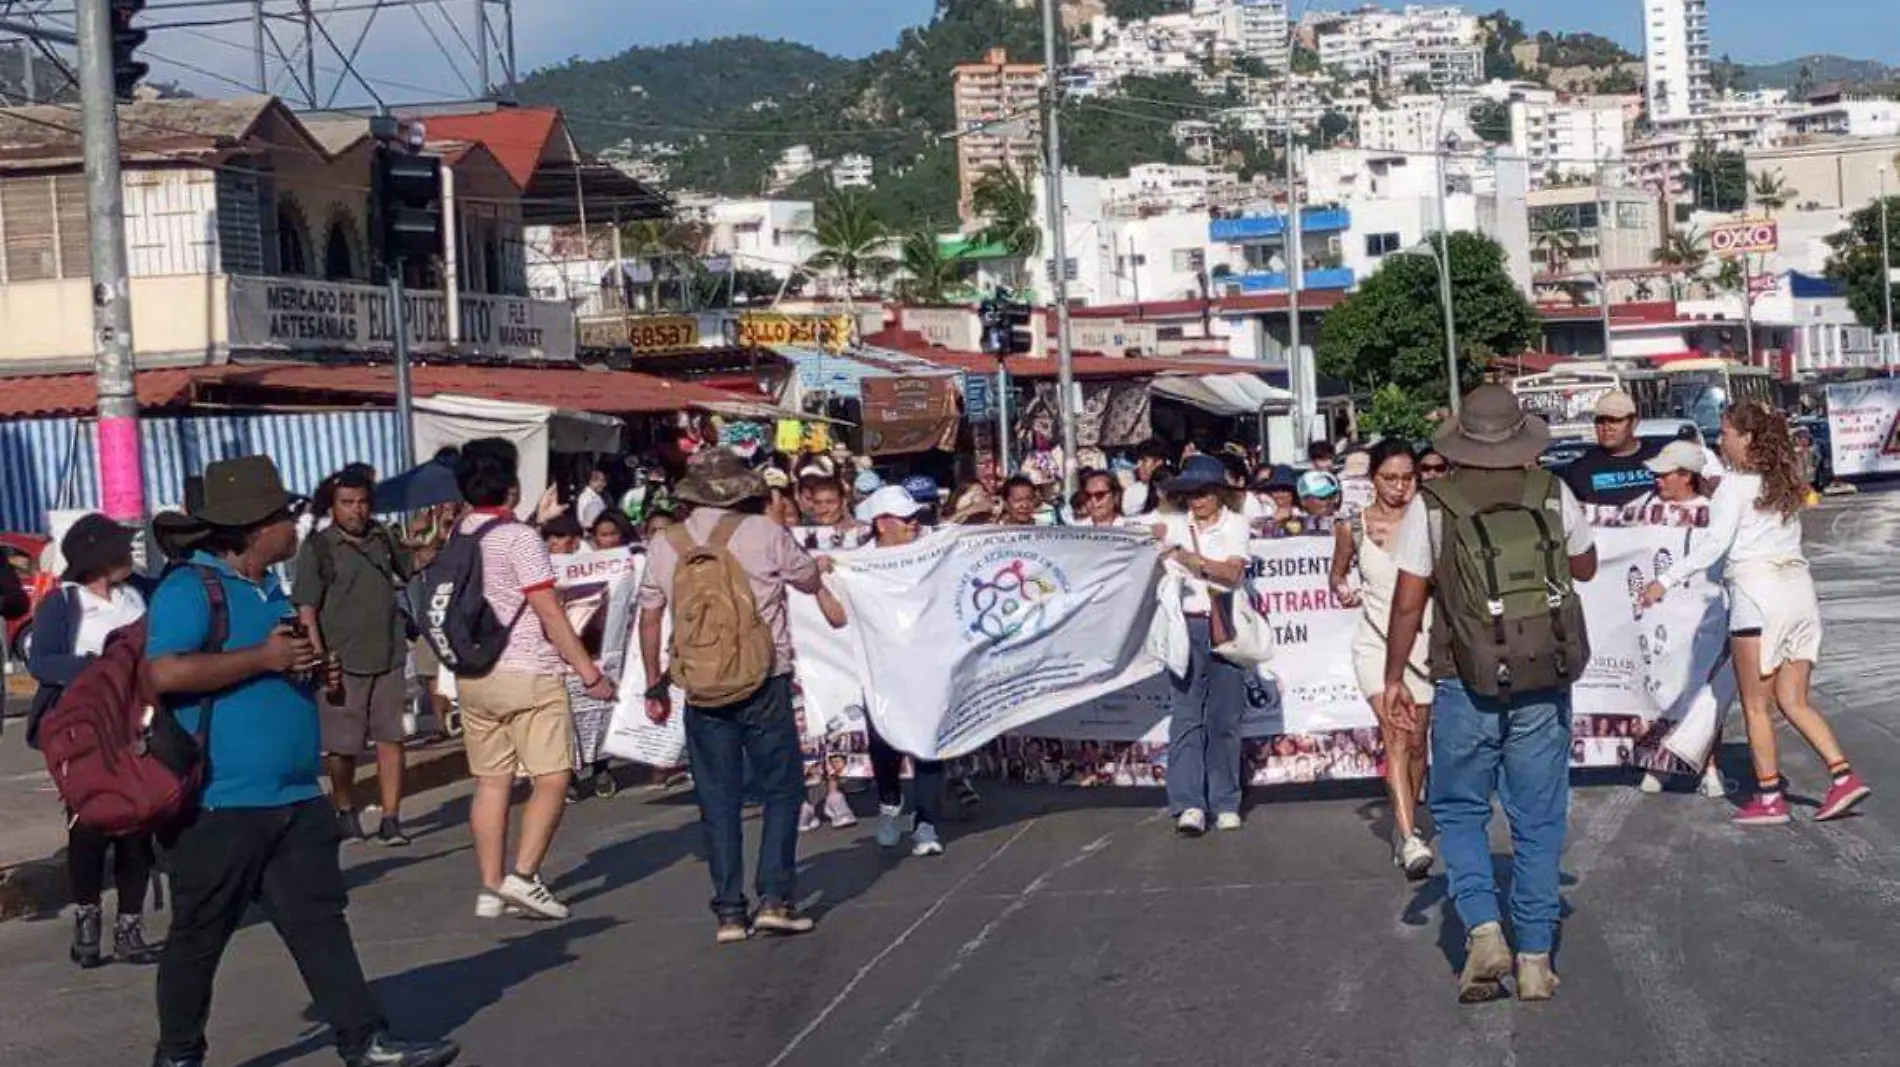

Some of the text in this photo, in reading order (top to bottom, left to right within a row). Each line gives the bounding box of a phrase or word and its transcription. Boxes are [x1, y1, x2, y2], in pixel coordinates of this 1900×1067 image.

[1713, 226, 1772, 250] OXXO
[267, 286, 356, 314] MERCADO DE
[566, 557, 635, 579] BUSCA
[1245, 556, 1332, 578] RESIDENT
[1254, 589, 1340, 613] NTRARL
[428, 581, 463, 666] adidas
[1273, 620, 1308, 645] TÁN
